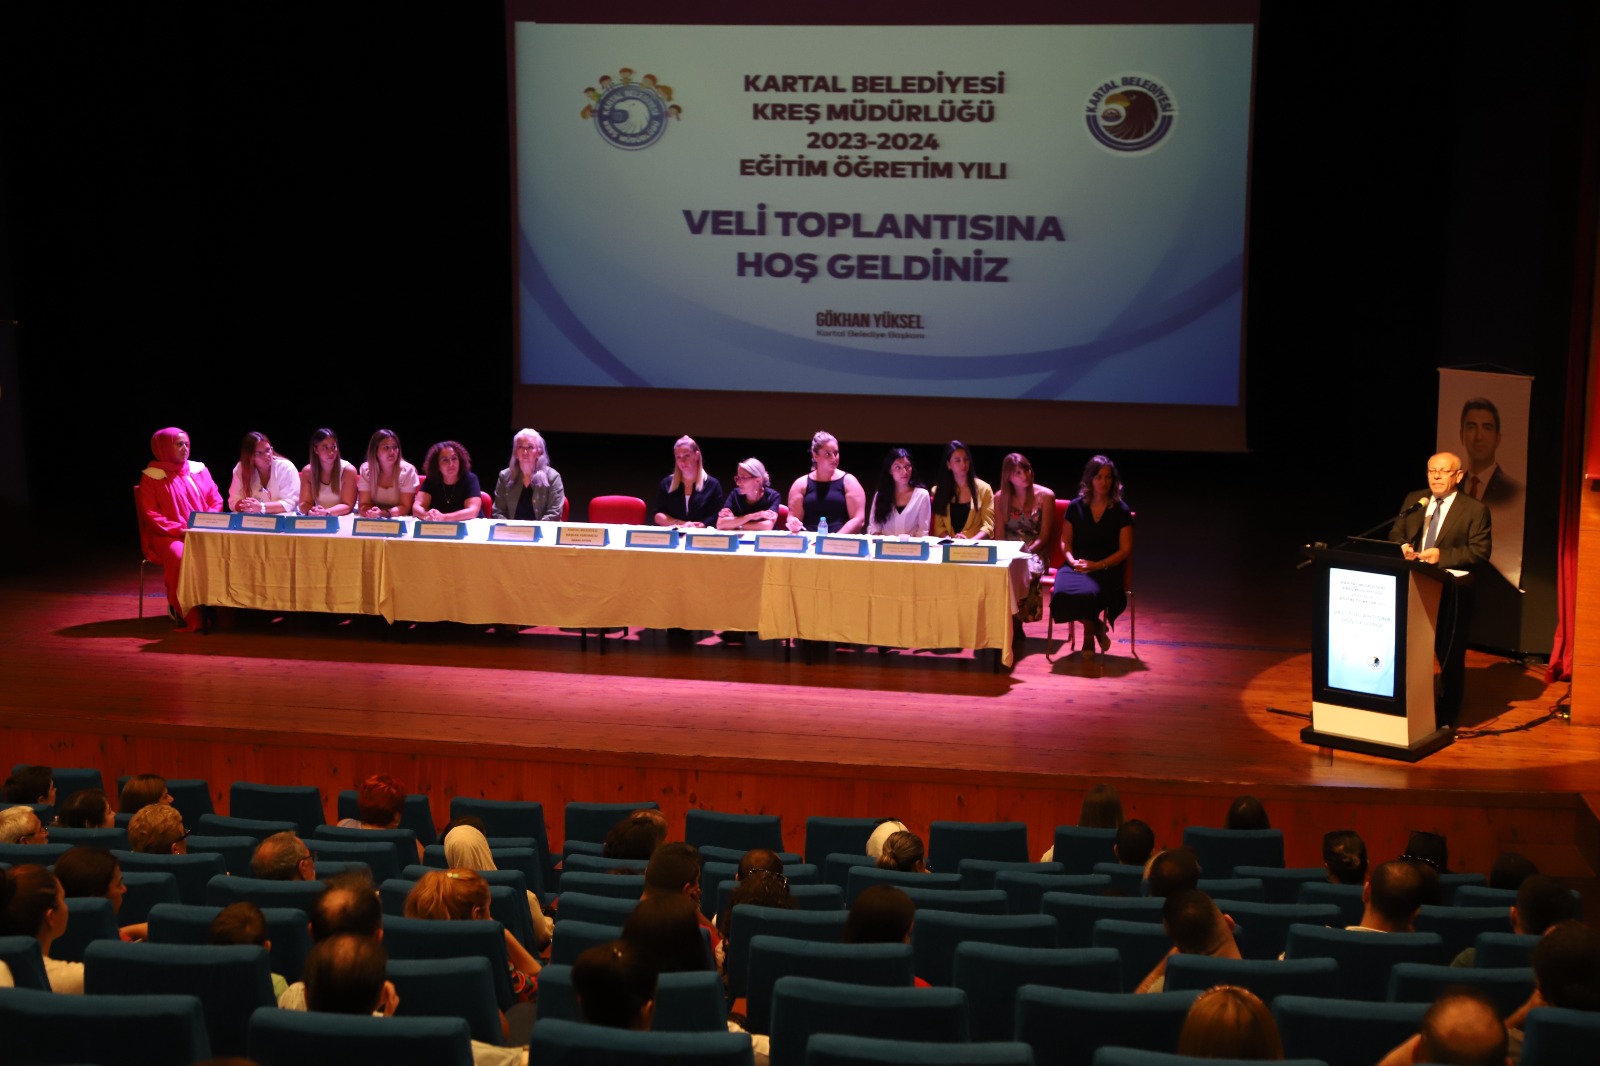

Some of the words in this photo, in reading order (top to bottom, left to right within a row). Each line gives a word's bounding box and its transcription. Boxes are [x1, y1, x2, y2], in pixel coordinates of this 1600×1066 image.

[744, 74, 847, 93] KARTAL
[852, 70, 1005, 94] BELEDİYESİ
[1086, 80, 1120, 112] KARTAL
[1121, 76, 1176, 112] BELEDİYESİ
[752, 102, 821, 124] KREŞ
[826, 98, 995, 122] MÜDÜRLÜĞÜ
[806, 132, 940, 150] 2023-2024
[740, 154, 828, 176] EĞİTİM
[834, 155, 952, 178] ÖĞRETİM
[958, 162, 1007, 179] YILI
[682, 202, 767, 236] VELİ
[774, 211, 1066, 242] TOPLANTISINA
[736, 252, 819, 284] HOŞ
[826, 248, 1009, 282] GELDİNİZ
[816, 310, 870, 328] GÖKHAN
[872, 311, 925, 329] YÜKSEL
[848, 330, 886, 339] Belediye
[888, 331, 925, 340] Başkanı
